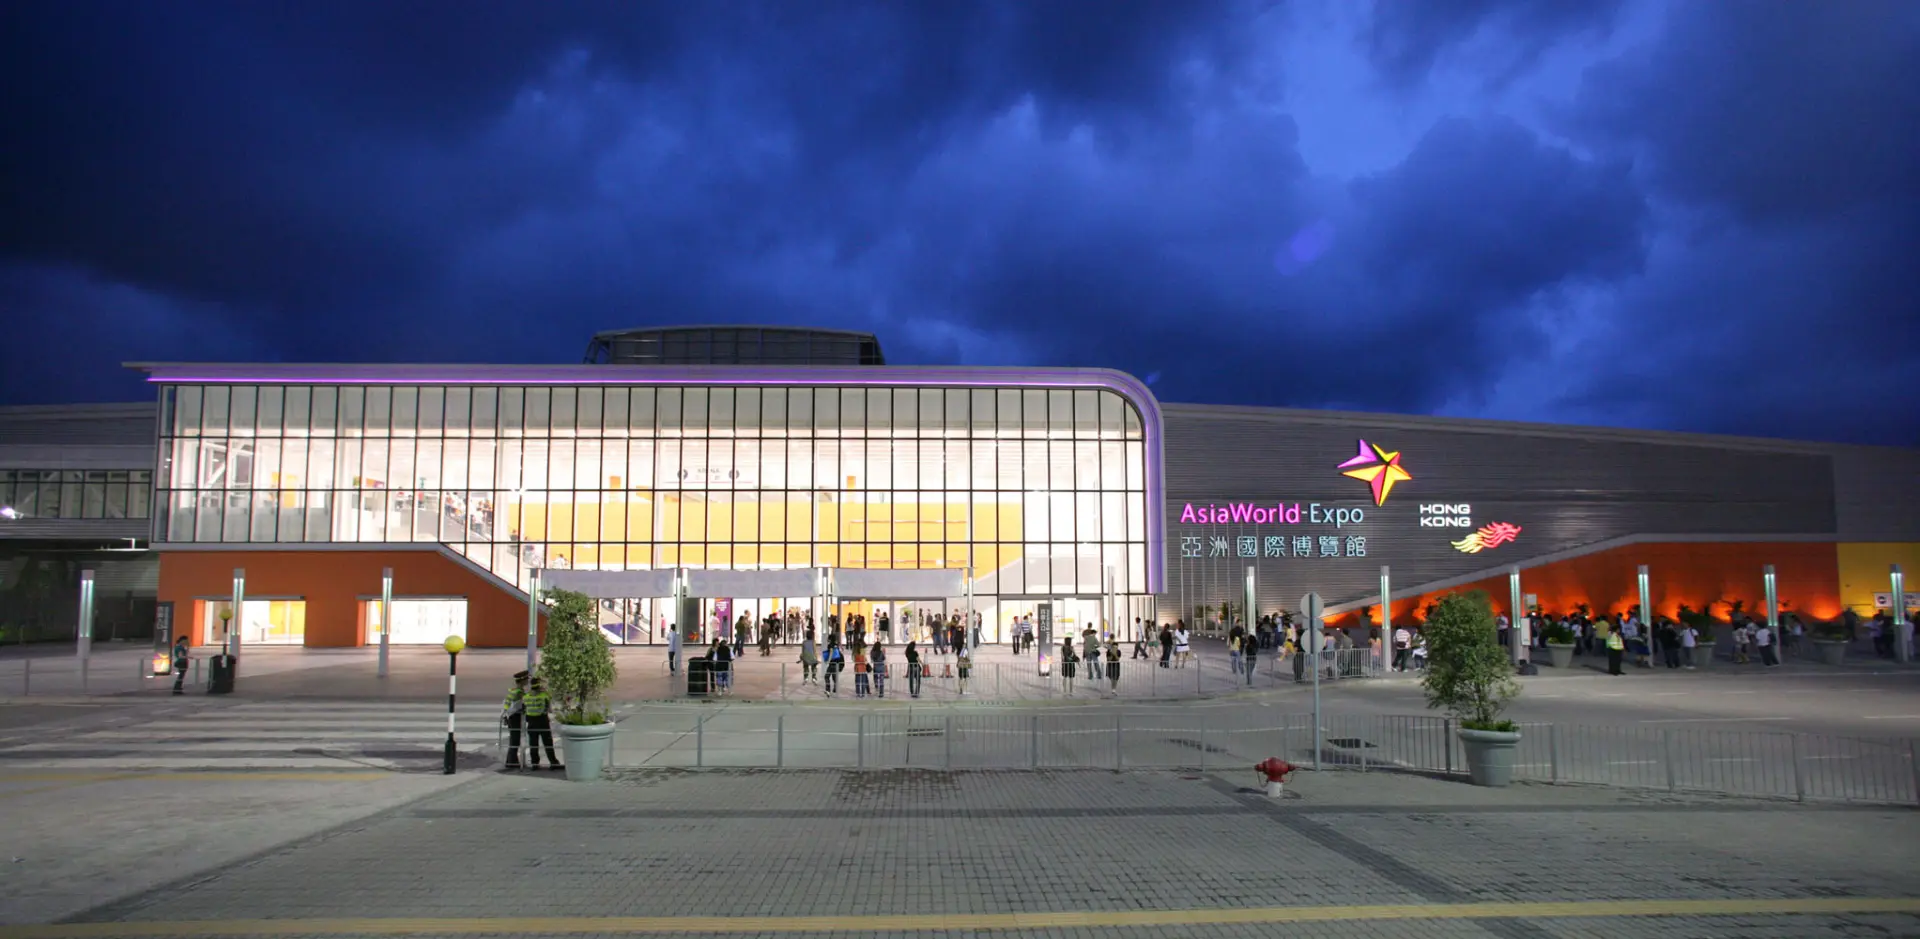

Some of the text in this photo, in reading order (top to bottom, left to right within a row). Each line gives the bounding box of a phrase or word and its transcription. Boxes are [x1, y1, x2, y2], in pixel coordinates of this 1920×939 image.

[1181, 503, 1364, 528] AsiaWorld-Expo
[1420, 504, 1470, 514] HONG
[1420, 517, 1471, 527] KONG
[1182, 536, 1366, 557] 亞洲國際博覽館
